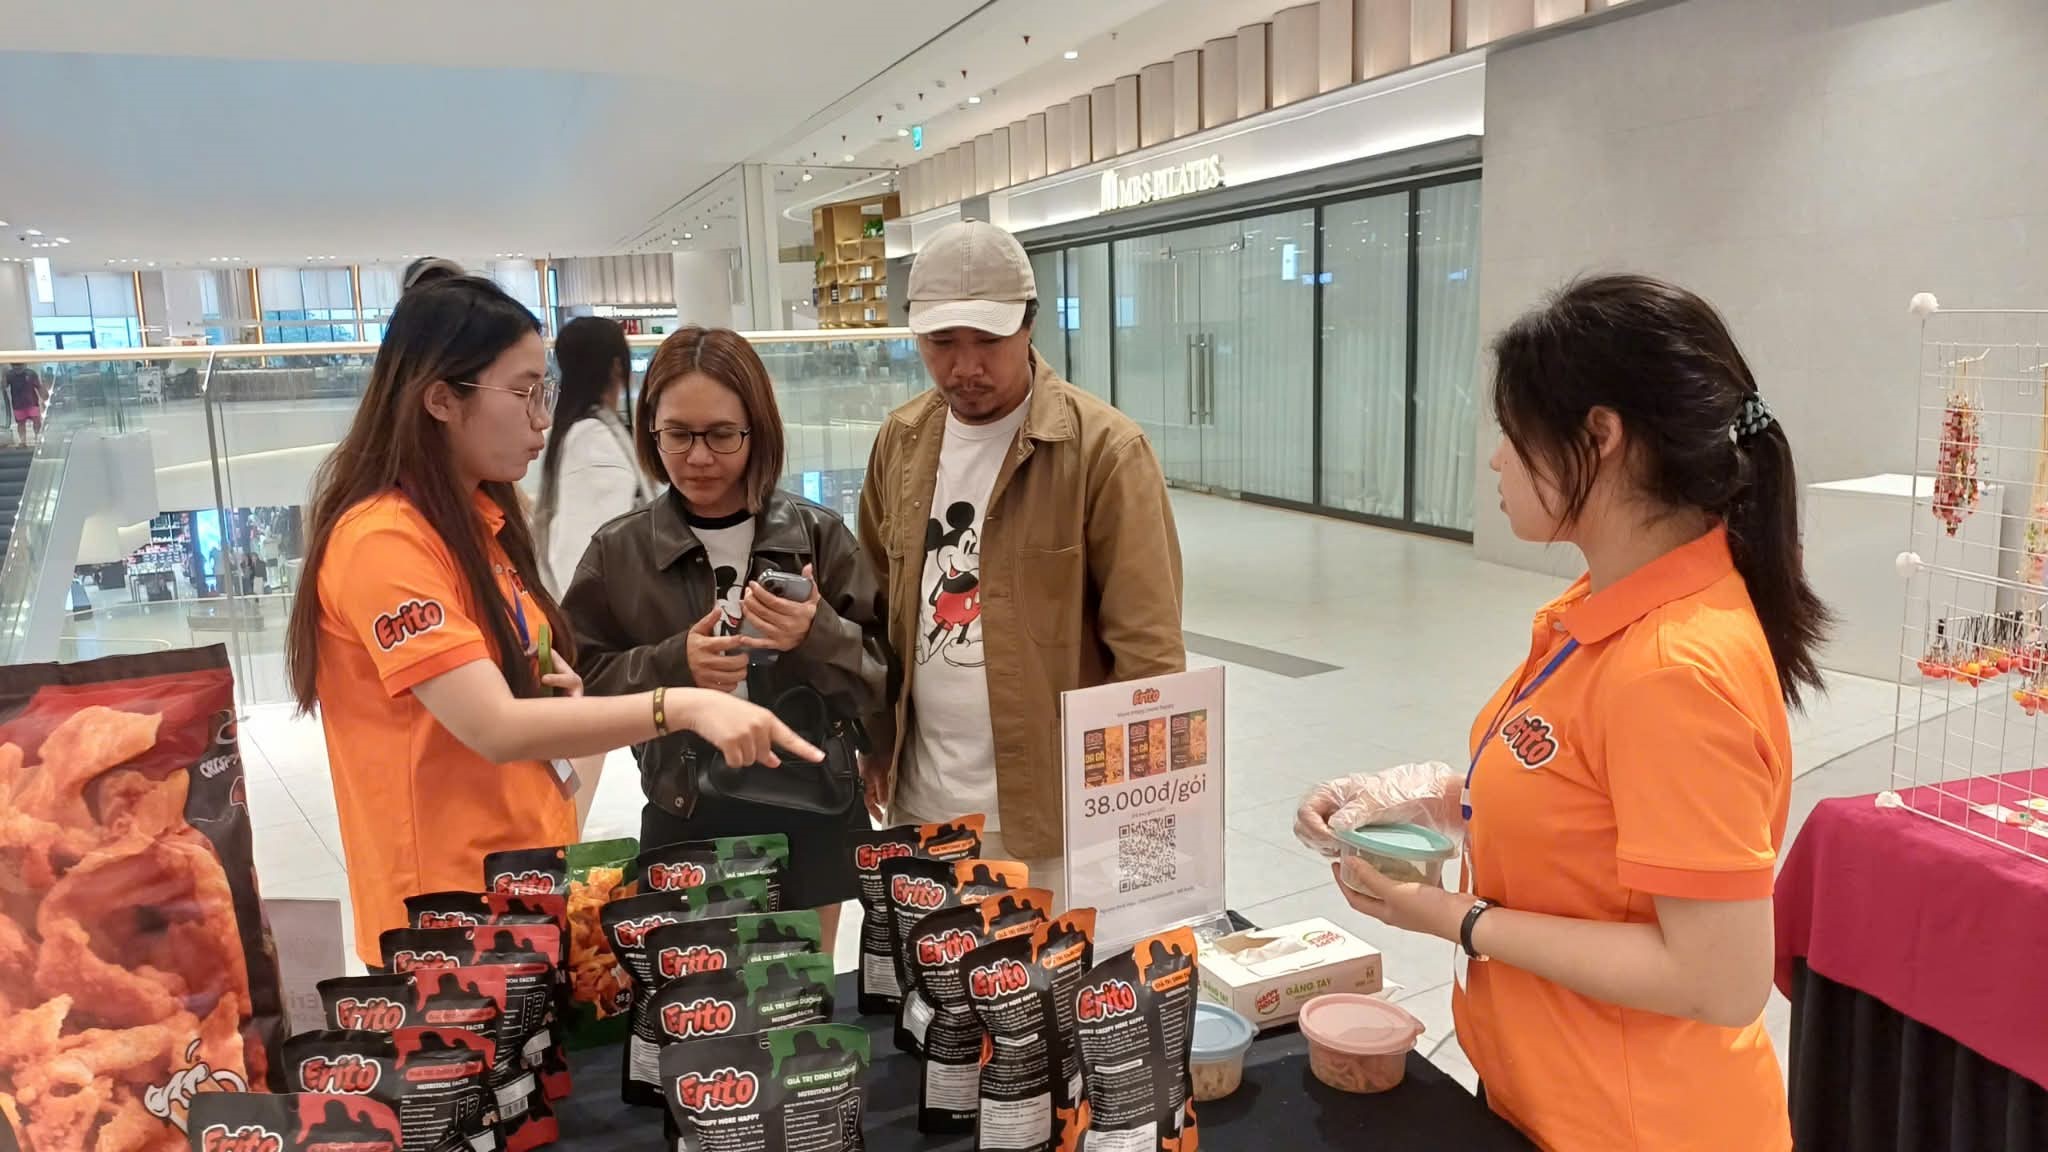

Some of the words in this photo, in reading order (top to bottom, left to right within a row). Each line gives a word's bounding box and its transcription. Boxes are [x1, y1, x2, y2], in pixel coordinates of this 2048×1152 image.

[1152, 155, 1220, 200] PILATES
[373, 598, 444, 652] Erito
[1084, 774, 1207, 818] 38.000đ/gói
[648, 861, 706, 892] Erito
[892, 873, 947, 910] Erito
[658, 944, 728, 980] Erito
[916, 928, 978, 967] Erito
[969, 957, 1030, 1000] Erito
[335, 996, 406, 1032] Erito
[660, 997, 736, 1039] Erito
[1076, 978, 1137, 1023] Erito
[300, 1053, 382, 1095] Erito
[675, 1066, 759, 1113] Erito
